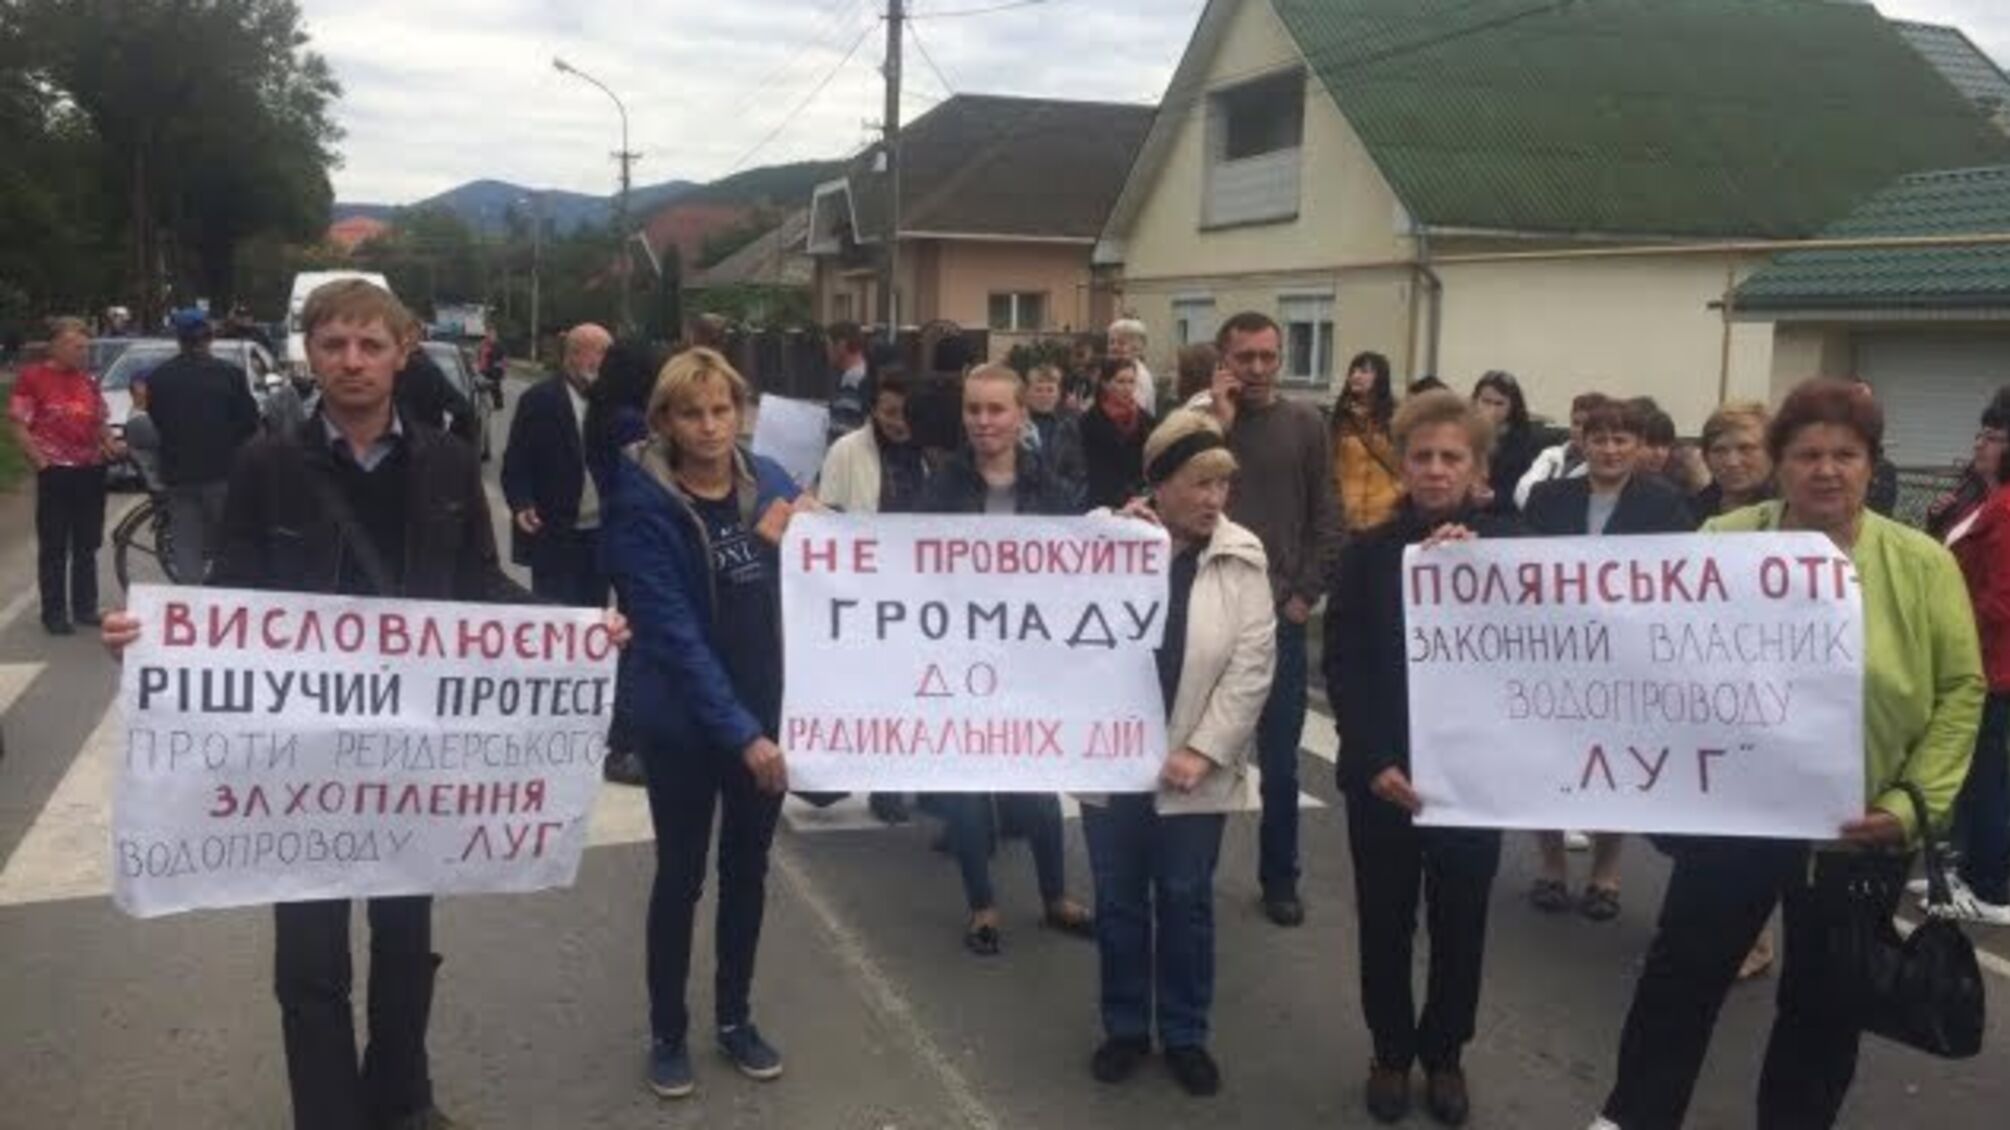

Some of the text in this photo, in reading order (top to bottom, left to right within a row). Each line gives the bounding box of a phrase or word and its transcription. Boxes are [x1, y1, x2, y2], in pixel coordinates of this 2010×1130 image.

[802, 538, 878, 573] НЕ
[914, 534, 1160, 574] ПРОВОКУЙТЕ
[1411, 557, 1730, 606] ПОЛЯНСЬКА
[163, 602, 611, 662] ВИСЛОВЛЮЄМО
[829, 598, 1160, 648] ГРОМАДУ
[1411, 620, 1853, 664] ЗАКОННИЙ ВЛАСНИК
[138, 664, 610, 717] РІШУЧИЙ ПРОТЕСТ
[914, 662, 998, 698] ДО
[1507, 679, 1794, 726] ВОДОПРОВОДУ
[127, 729, 298, 770] ПРОТИ
[787, 715, 1144, 758] РАДИКАЛЬНИХ ДІЙ
[120, 829, 413, 877] ВОДОПРОВОДУ
